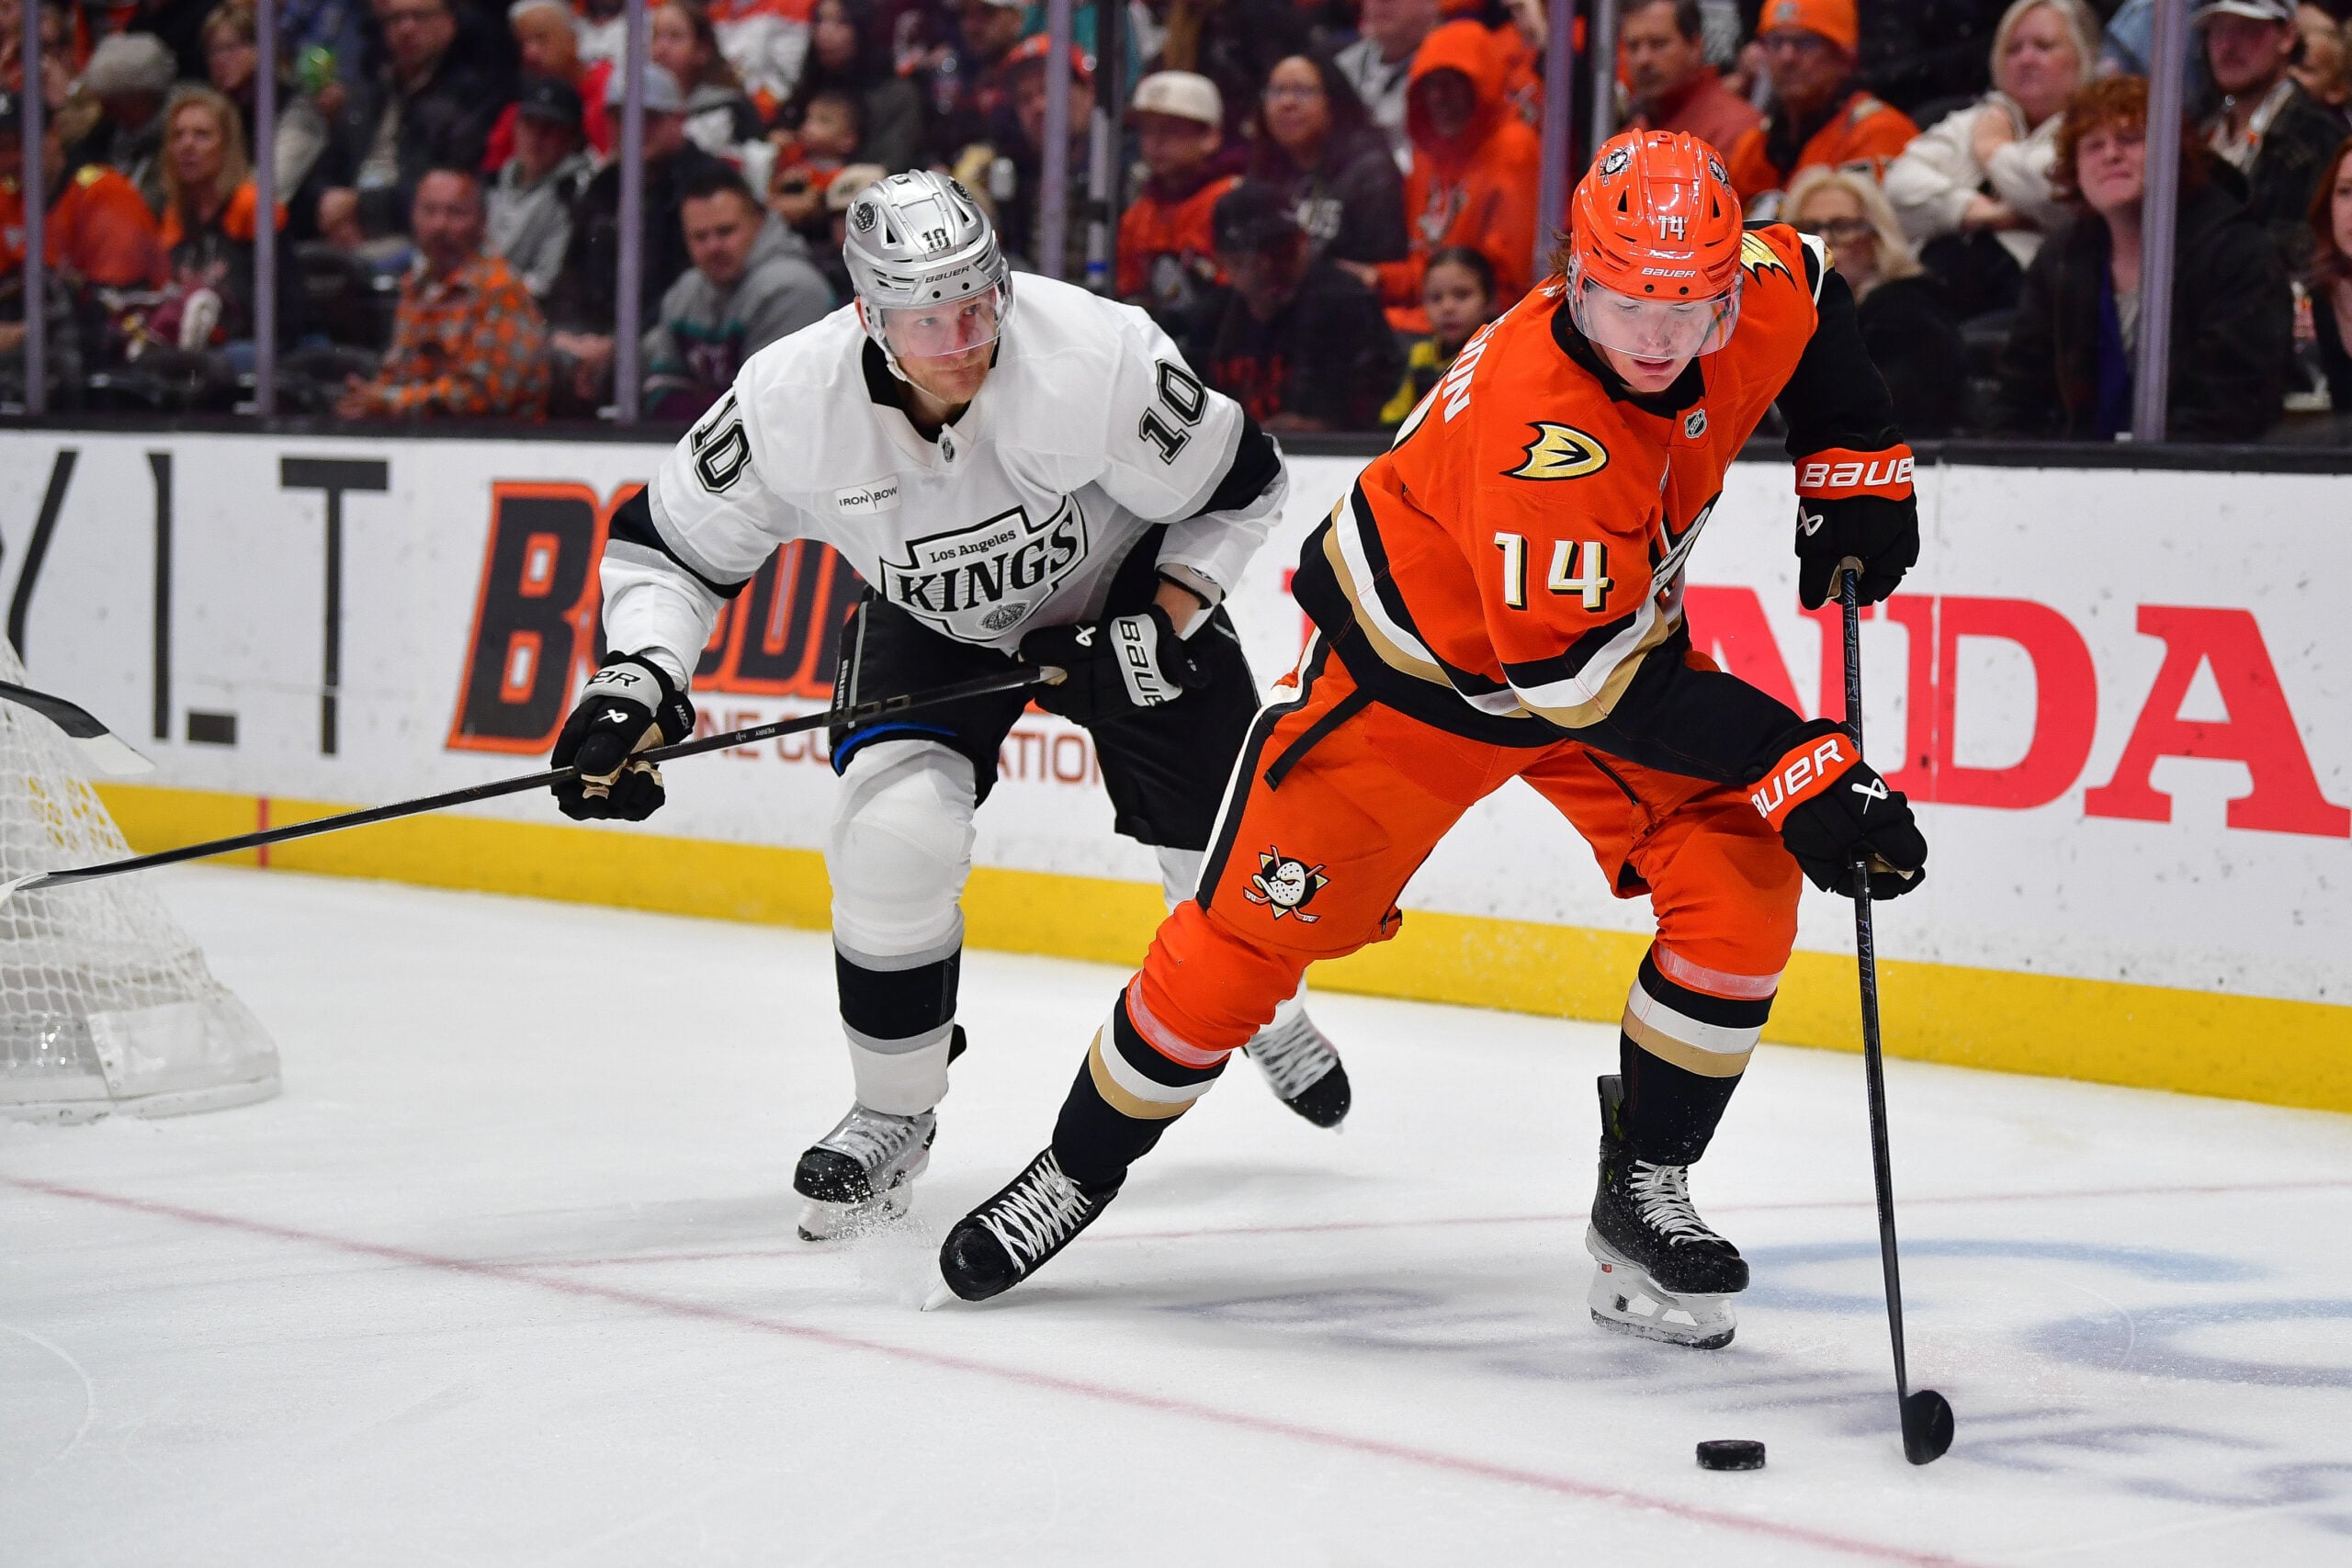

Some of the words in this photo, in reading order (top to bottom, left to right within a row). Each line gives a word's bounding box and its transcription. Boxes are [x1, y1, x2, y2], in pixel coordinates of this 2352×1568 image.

[922, 228, 951, 253] 10
[1657, 215, 1685, 241] 14
[924, 265, 970, 284] BAUER
[1641, 266, 1696, 278] BAUER
[1138, 358, 1208, 466] 10
[689, 390, 752, 493] 10
[838, 494, 869, 507] IRON
[873, 486, 898, 502] BOW
[896, 510, 1078, 613] KINGS
[929, 549, 956, 564] Los
[958, 528, 1017, 557] Angeles
[1493, 531, 1615, 614] 14
